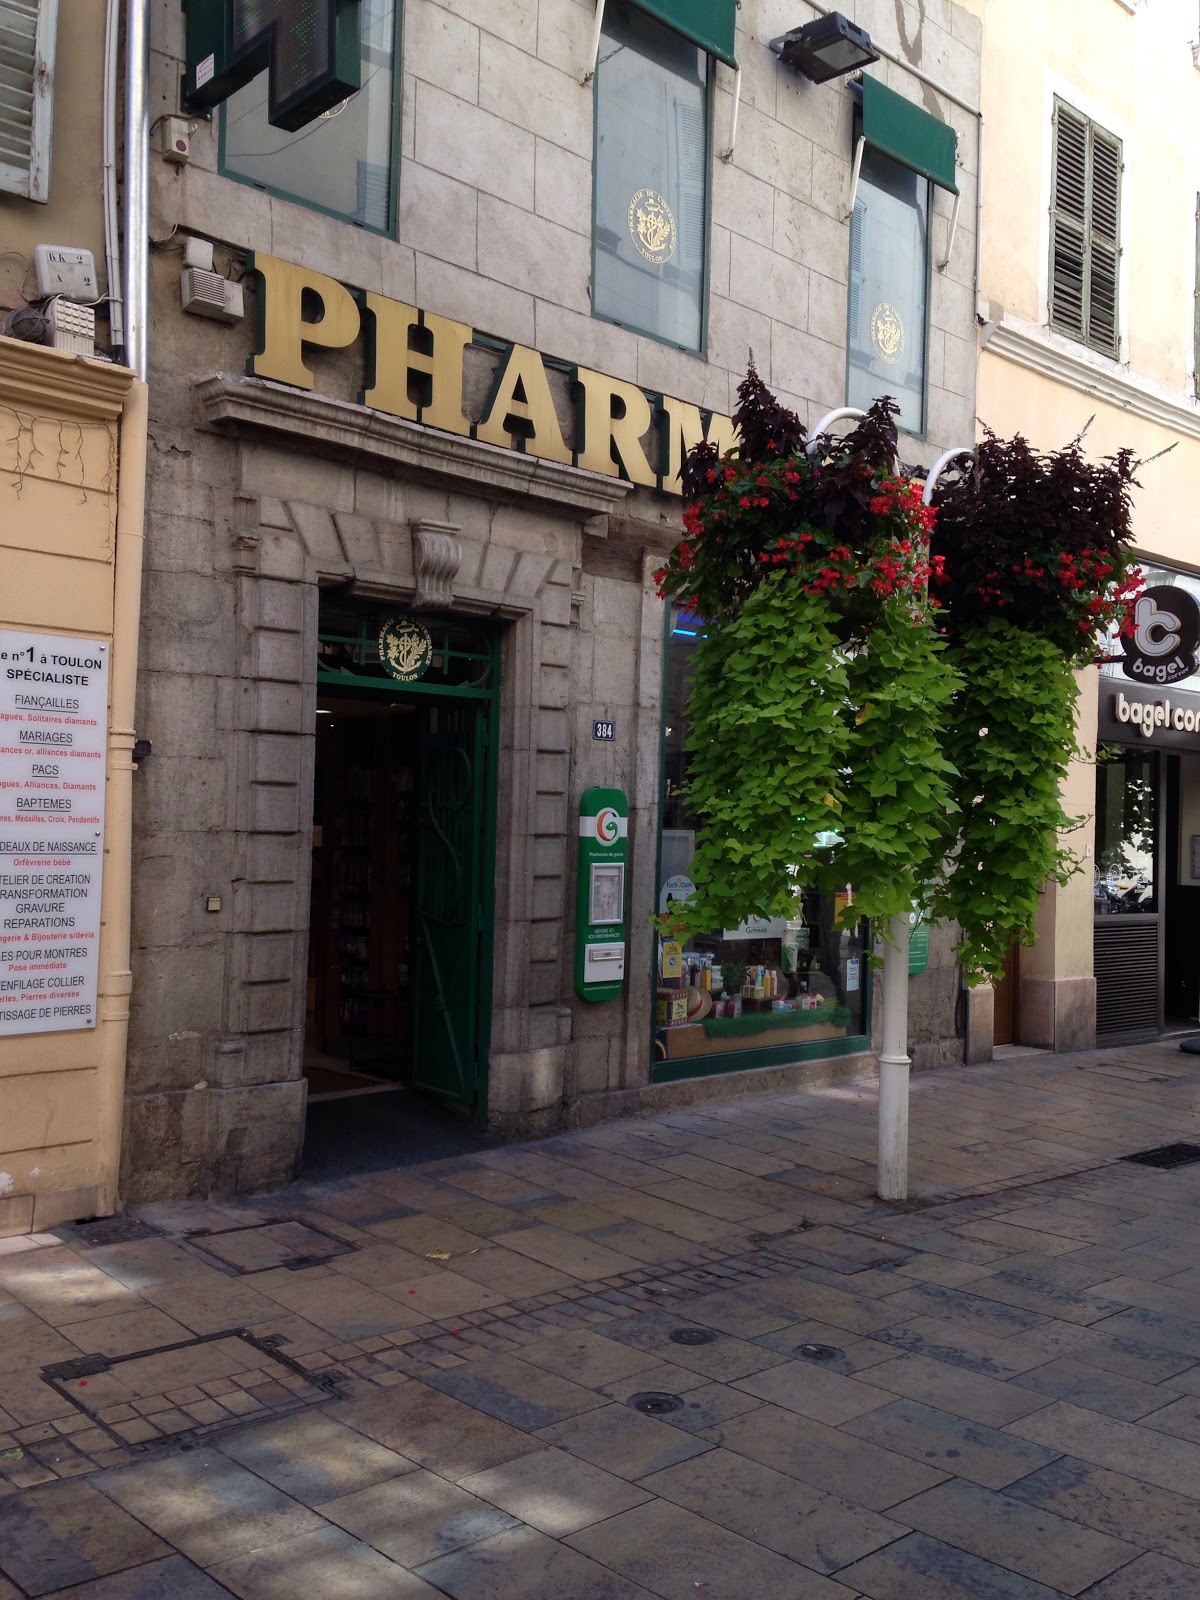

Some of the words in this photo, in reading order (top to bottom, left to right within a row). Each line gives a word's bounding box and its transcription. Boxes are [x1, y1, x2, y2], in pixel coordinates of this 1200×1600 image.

[40, 654, 47, 664] à
[51, 655, 102, 670] TOULON
[392, 671, 418, 681] TOULON
[1132, 656, 1185, 683] bagel
[1167, 667, 1190, 681] corner
[6, 668, 89, 686] SPÉCIALISTE
[15, 694, 79, 709] FIANÇAILLES
[27, 713, 62, 724] Solitaires
[64, 716, 97, 726] diamants
[1116, 692, 1171, 738] bagel
[19, 730, 73, 743] MARIAGES
[597, 723, 612, 738] 384
[36, 748, 68, 757] alliances
[69, 749, 102, 759] diamants
[32, 764, 59, 775] PACS
[24, 780, 61, 790] Alliances,
[62, 782, 97, 791] Diamants
[16, 797, 72, 809] BAPTEMES
[68, 815, 100, 824] Pendentifs
[32, 841, 45, 852] DE
[47, 841, 97, 852] NAISSANCE
[31, 874, 44, 885] DE
[46, 874, 91, 885] CREATION
[15, 902, 65, 914] GRAVURE
[3, 916, 75, 929] REPARATIONS
[23, 933, 29, 941] &
[31, 931, 68, 942] Bijouterie
[69, 931, 95, 939] s/devis
[0, 951, 14, 962] ES
[15, 949, 42, 961] POUR
[44, 947, 88, 960] MONTRES
[8, 963, 28, 972] Pose
[29, 961, 68, 971] immédiate
[47, 975, 85, 988] COLLIER
[20, 993, 47, 1002] Pierres
[49, 990, 80, 1000] diverses
[38, 1007, 52, 1019] DE
[53, 1004, 92, 1017] PIERRES
